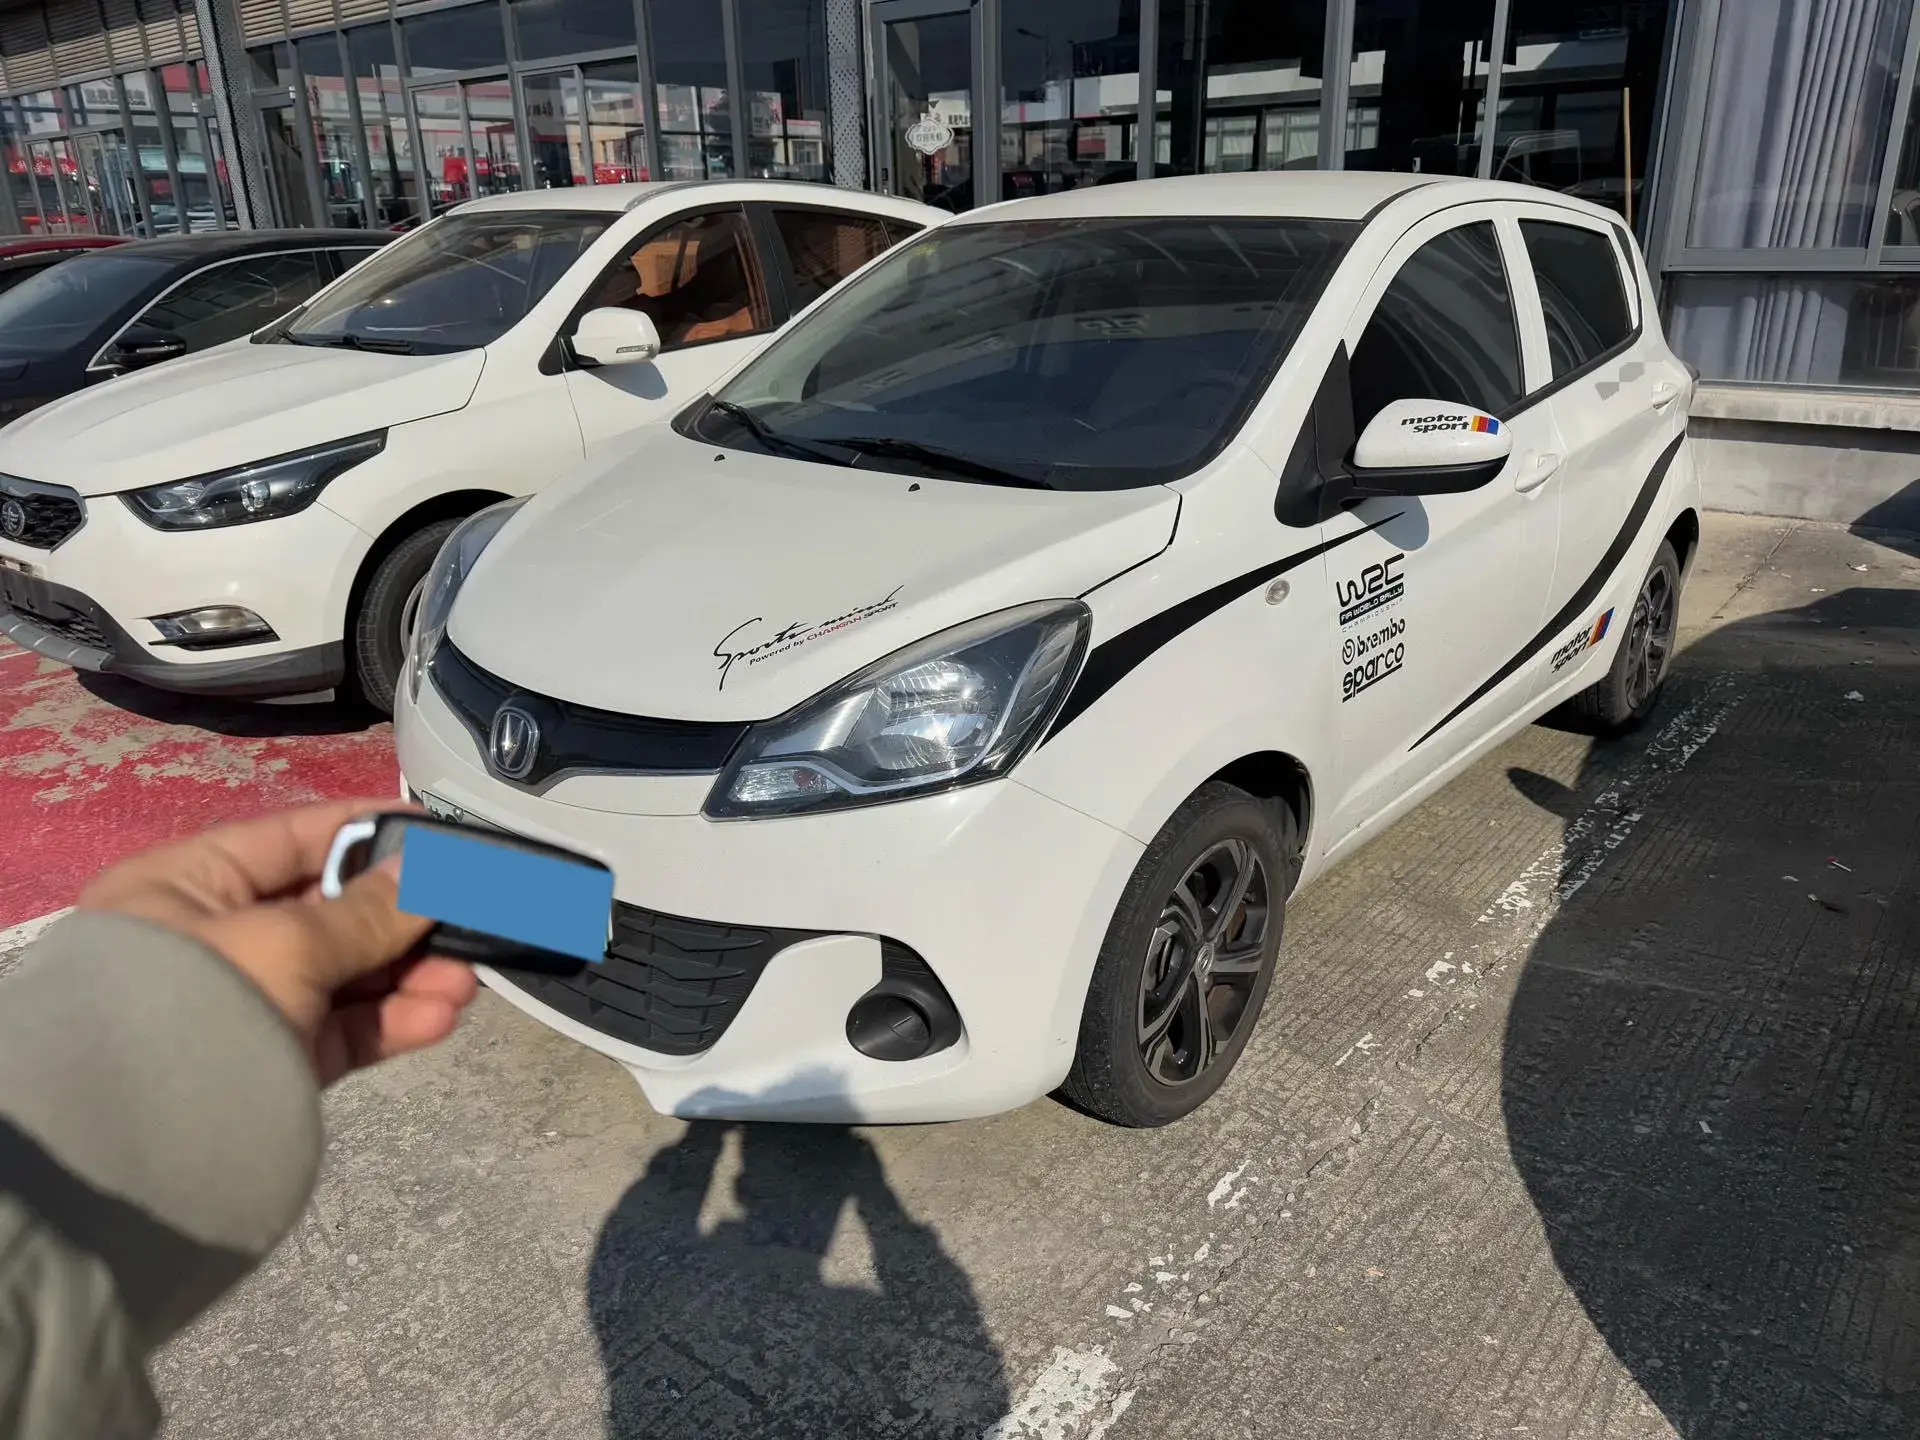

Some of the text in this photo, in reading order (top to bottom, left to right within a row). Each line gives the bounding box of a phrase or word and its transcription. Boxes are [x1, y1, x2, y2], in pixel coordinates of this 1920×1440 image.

[1400, 414, 1467, 425] motor
[1412, 421, 1469, 433] sport
[1336, 553, 1405, 607] WRC
[1353, 598, 1379, 616] WORLD
[1379, 585, 1404, 603] RALLY
[749, 601, 899, 665] Powered by CHANGAN SPORT
[1357, 618, 1406, 657] brembo
[1550, 624, 1594, 665] motor
[1343, 642, 1405, 699] sparco
[1551, 636, 1591, 674] sport
